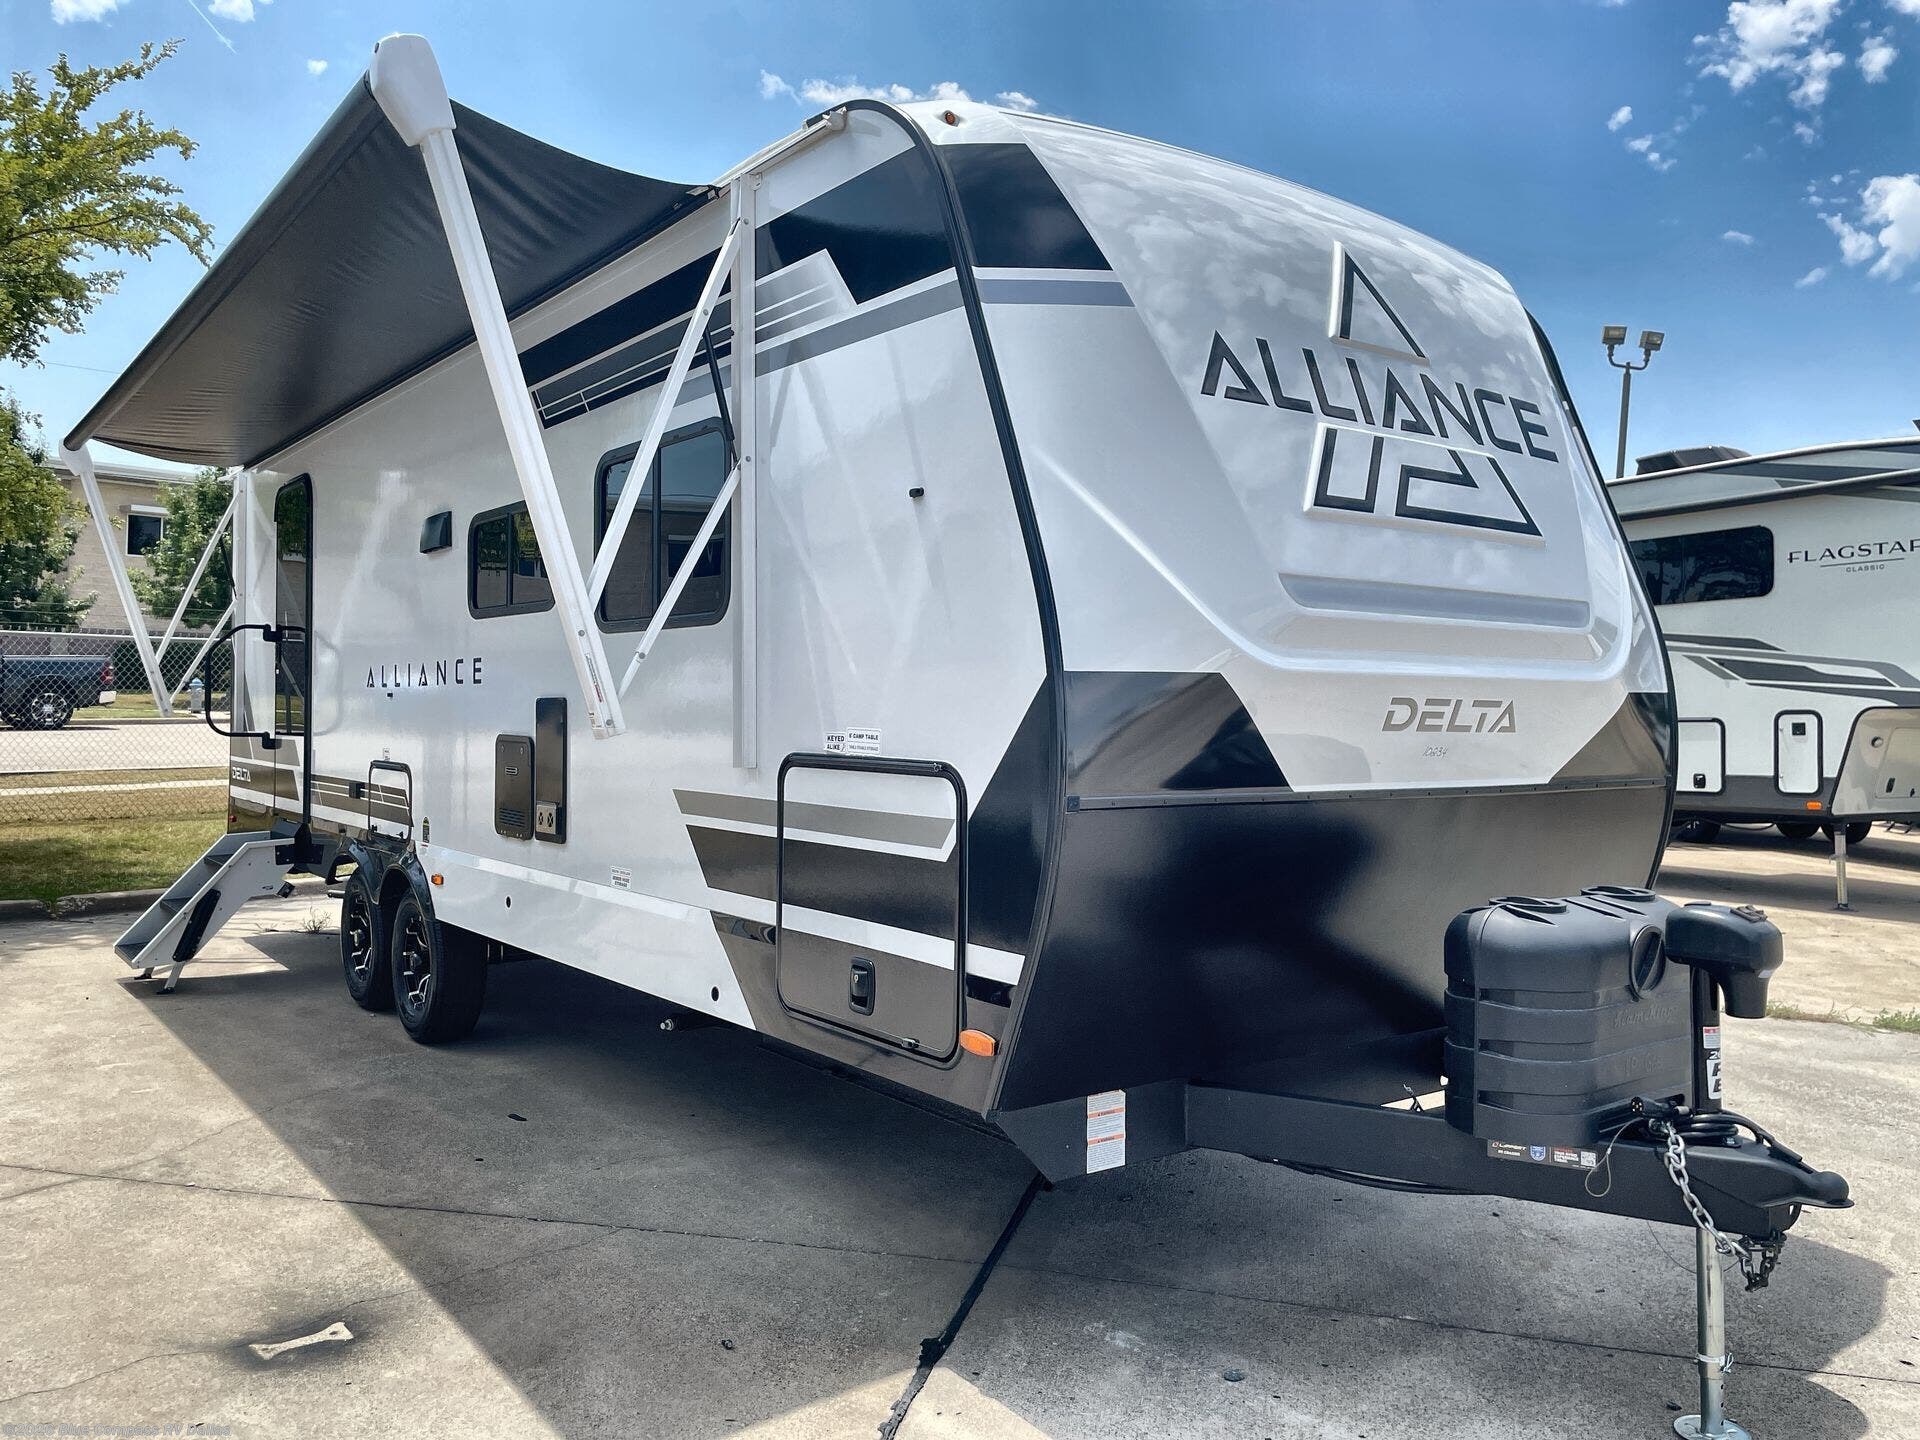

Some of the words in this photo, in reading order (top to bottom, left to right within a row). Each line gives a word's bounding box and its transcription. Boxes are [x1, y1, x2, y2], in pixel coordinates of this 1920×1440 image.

[1200, 329, 1560, 463] ALLIANCE
[1845, 563, 1885, 573] CLASSIC
[366, 657, 482, 688] ALLIANCE
[1381, 697, 1516, 733] DELTA
[827, 743, 841, 751] ALIKE
[232, 766, 251, 782] DELTA
